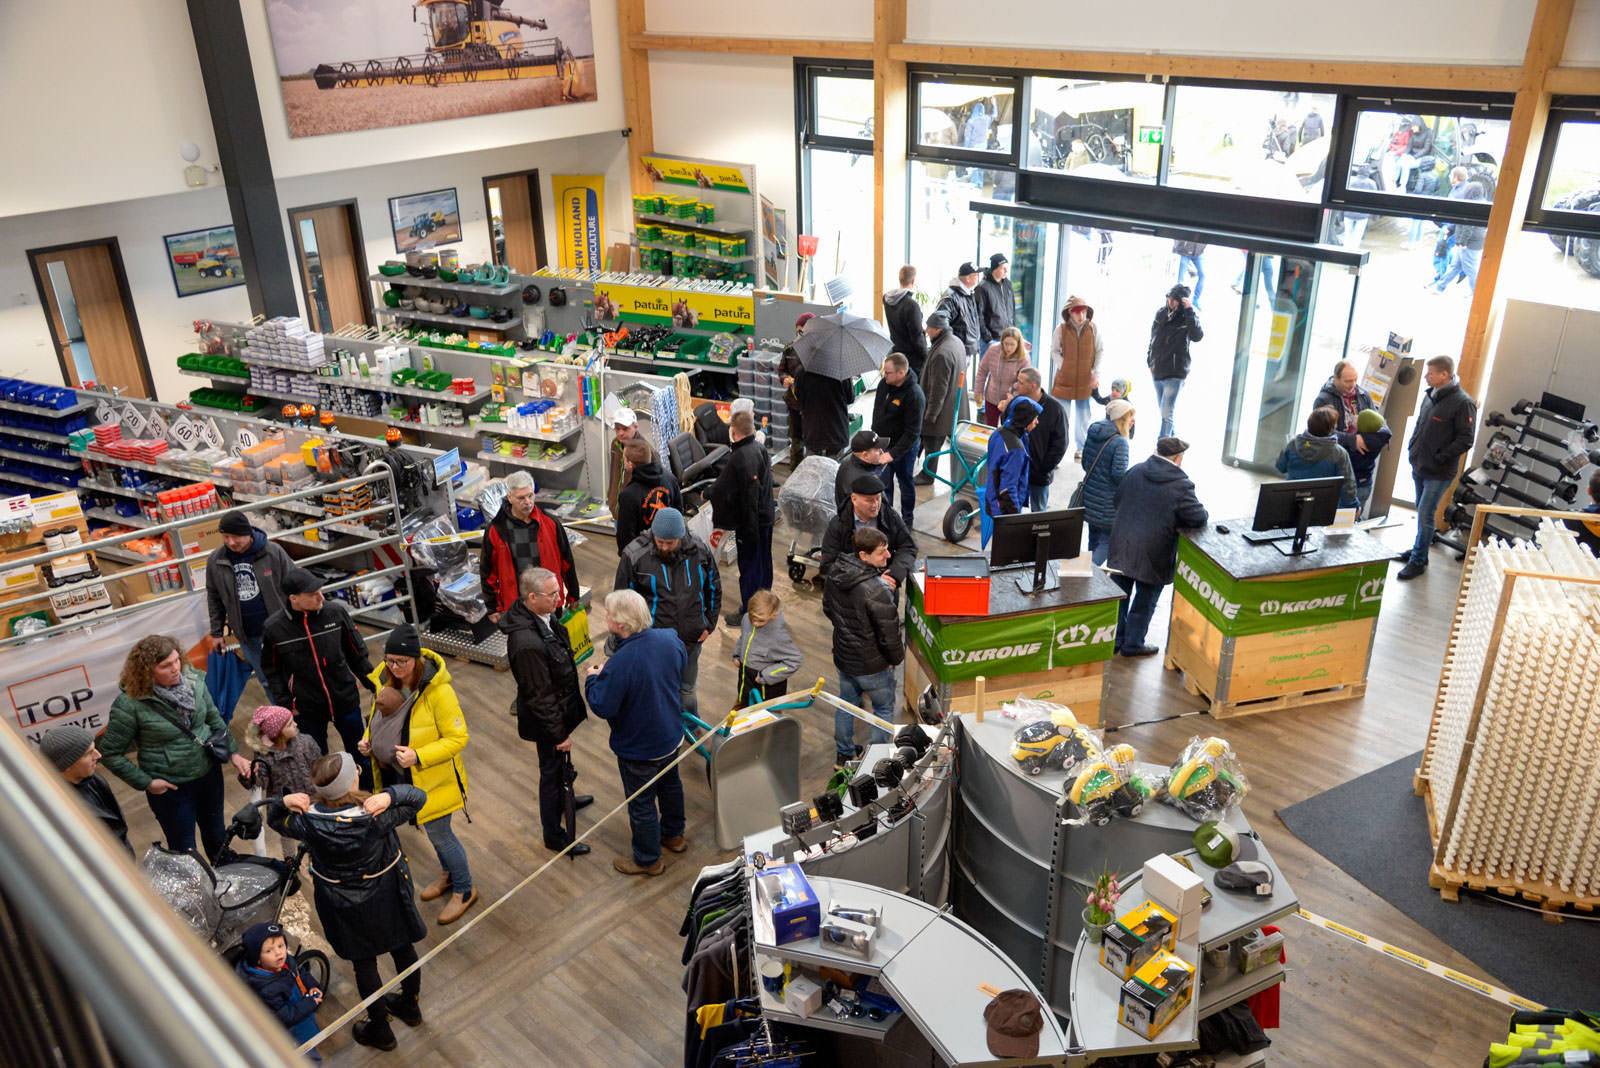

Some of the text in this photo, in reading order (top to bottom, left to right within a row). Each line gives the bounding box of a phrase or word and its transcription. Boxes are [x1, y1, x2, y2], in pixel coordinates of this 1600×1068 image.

[571, 196, 584, 274] NEW HOLLAND
[587, 215, 598, 274] AGRICULTURE
[634, 299, 669, 312] patura
[714, 307, 751, 320] patura
[102, 411, 110, 421] 6
[126, 411, 139, 427] 20
[177, 425, 193, 441] 60
[239, 433, 252, 447] 40
[1177, 560, 1242, 620] KRONE
[1280, 594, 1348, 614] KRONE
[1091, 624, 1118, 644] K
[965, 642, 1043, 663] KRONE
[16, 688, 94, 724] TOP
